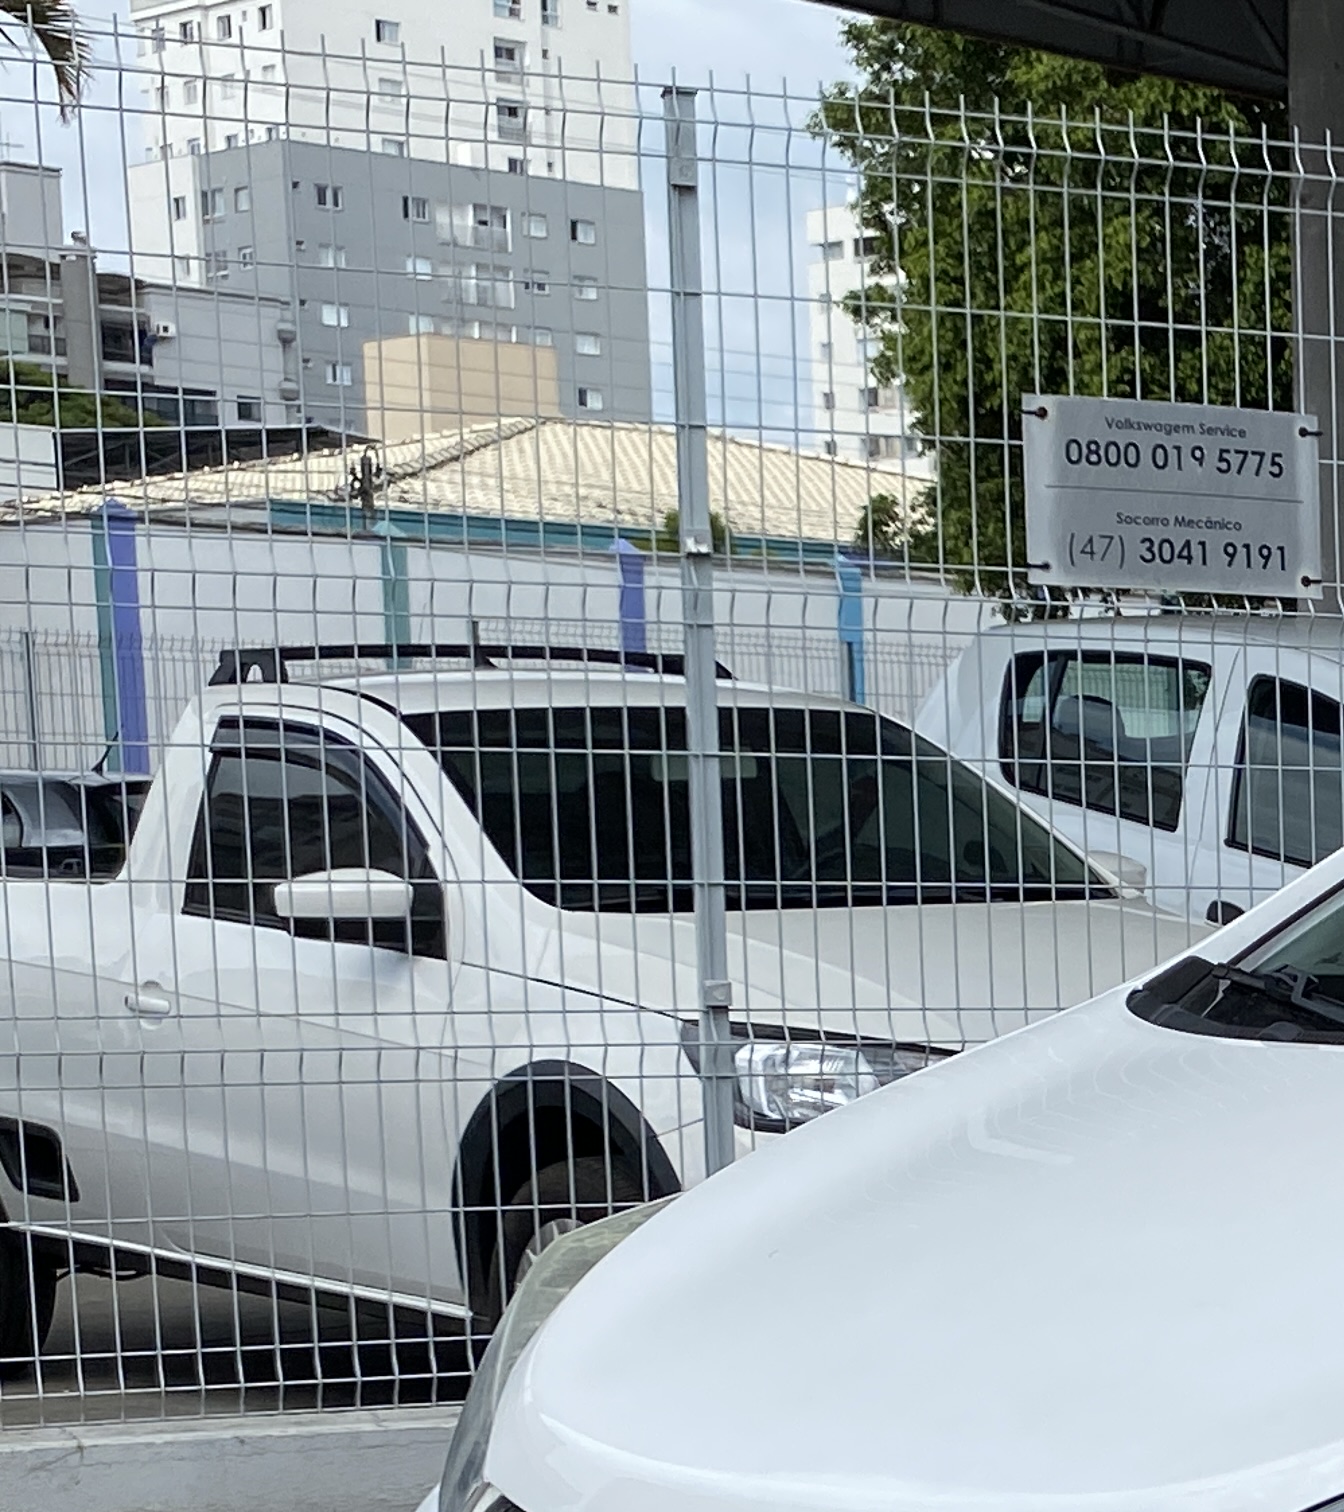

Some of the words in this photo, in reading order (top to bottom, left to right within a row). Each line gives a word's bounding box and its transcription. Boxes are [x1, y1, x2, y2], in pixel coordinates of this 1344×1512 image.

[1104, 416, 1195, 436] Volkswagem
[1199, 423, 1247, 438] Service
[1065, 438, 1141, 468] 0800
[1151, 443, 1206, 471] 019
[1216, 448, 1284, 479] 5775
[1116, 512, 1170, 527] Socorro
[1173, 515, 1243, 532] Mecânico
[1068, 532, 1126, 569] (47)
[1138, 537, 1208, 566] 3041
[1222, 542, 1287, 571] 9191
